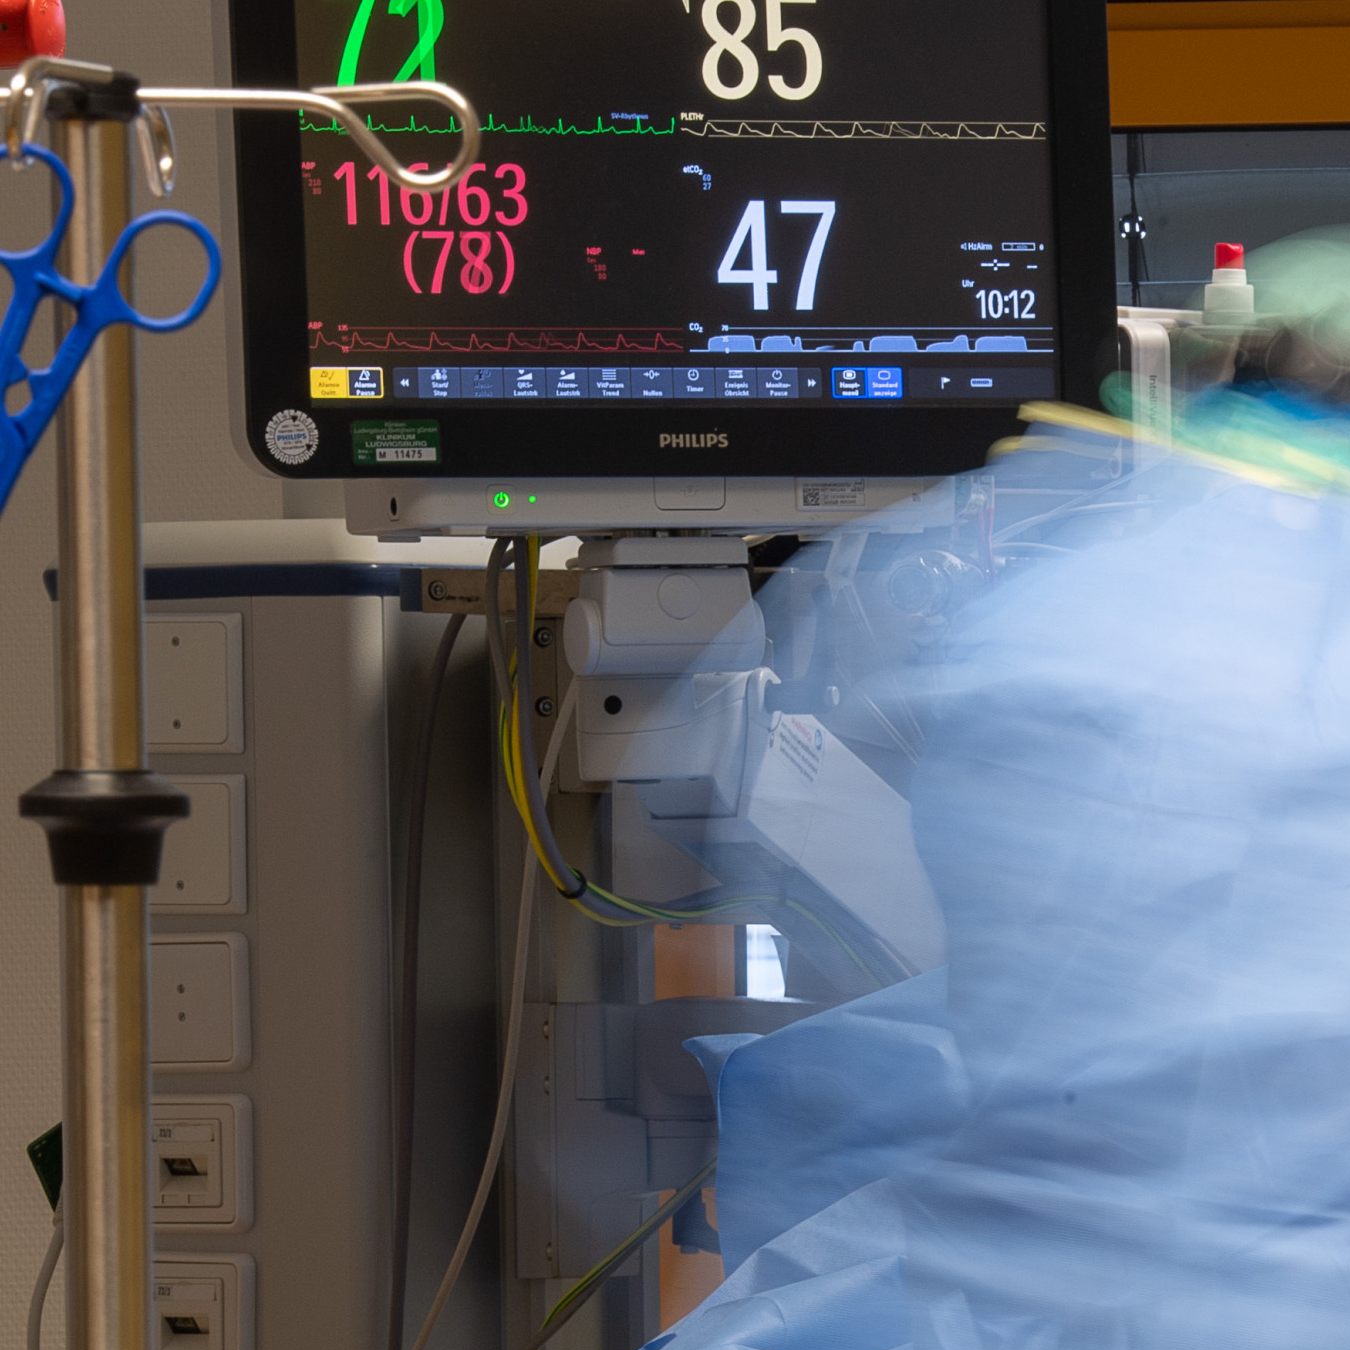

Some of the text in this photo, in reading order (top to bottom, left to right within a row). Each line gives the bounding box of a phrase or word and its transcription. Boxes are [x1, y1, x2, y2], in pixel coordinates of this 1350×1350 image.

[702, 0, 822, 99] 85
[333, 161, 528, 226] 116/63
[717, 200, 836, 310] 47
[961, 279, 975, 288] Uhr
[975, 289, 1036, 319] 10:12
[602, 389, 620, 397] Trend
[686, 385, 704, 393] Timer
[276, 432, 308, 441] PHILIPS
[659, 433, 729, 448] PHILIPS
[365, 440, 428, 448] LUDWIGSBURG
[378, 450, 423, 459] M 11475
